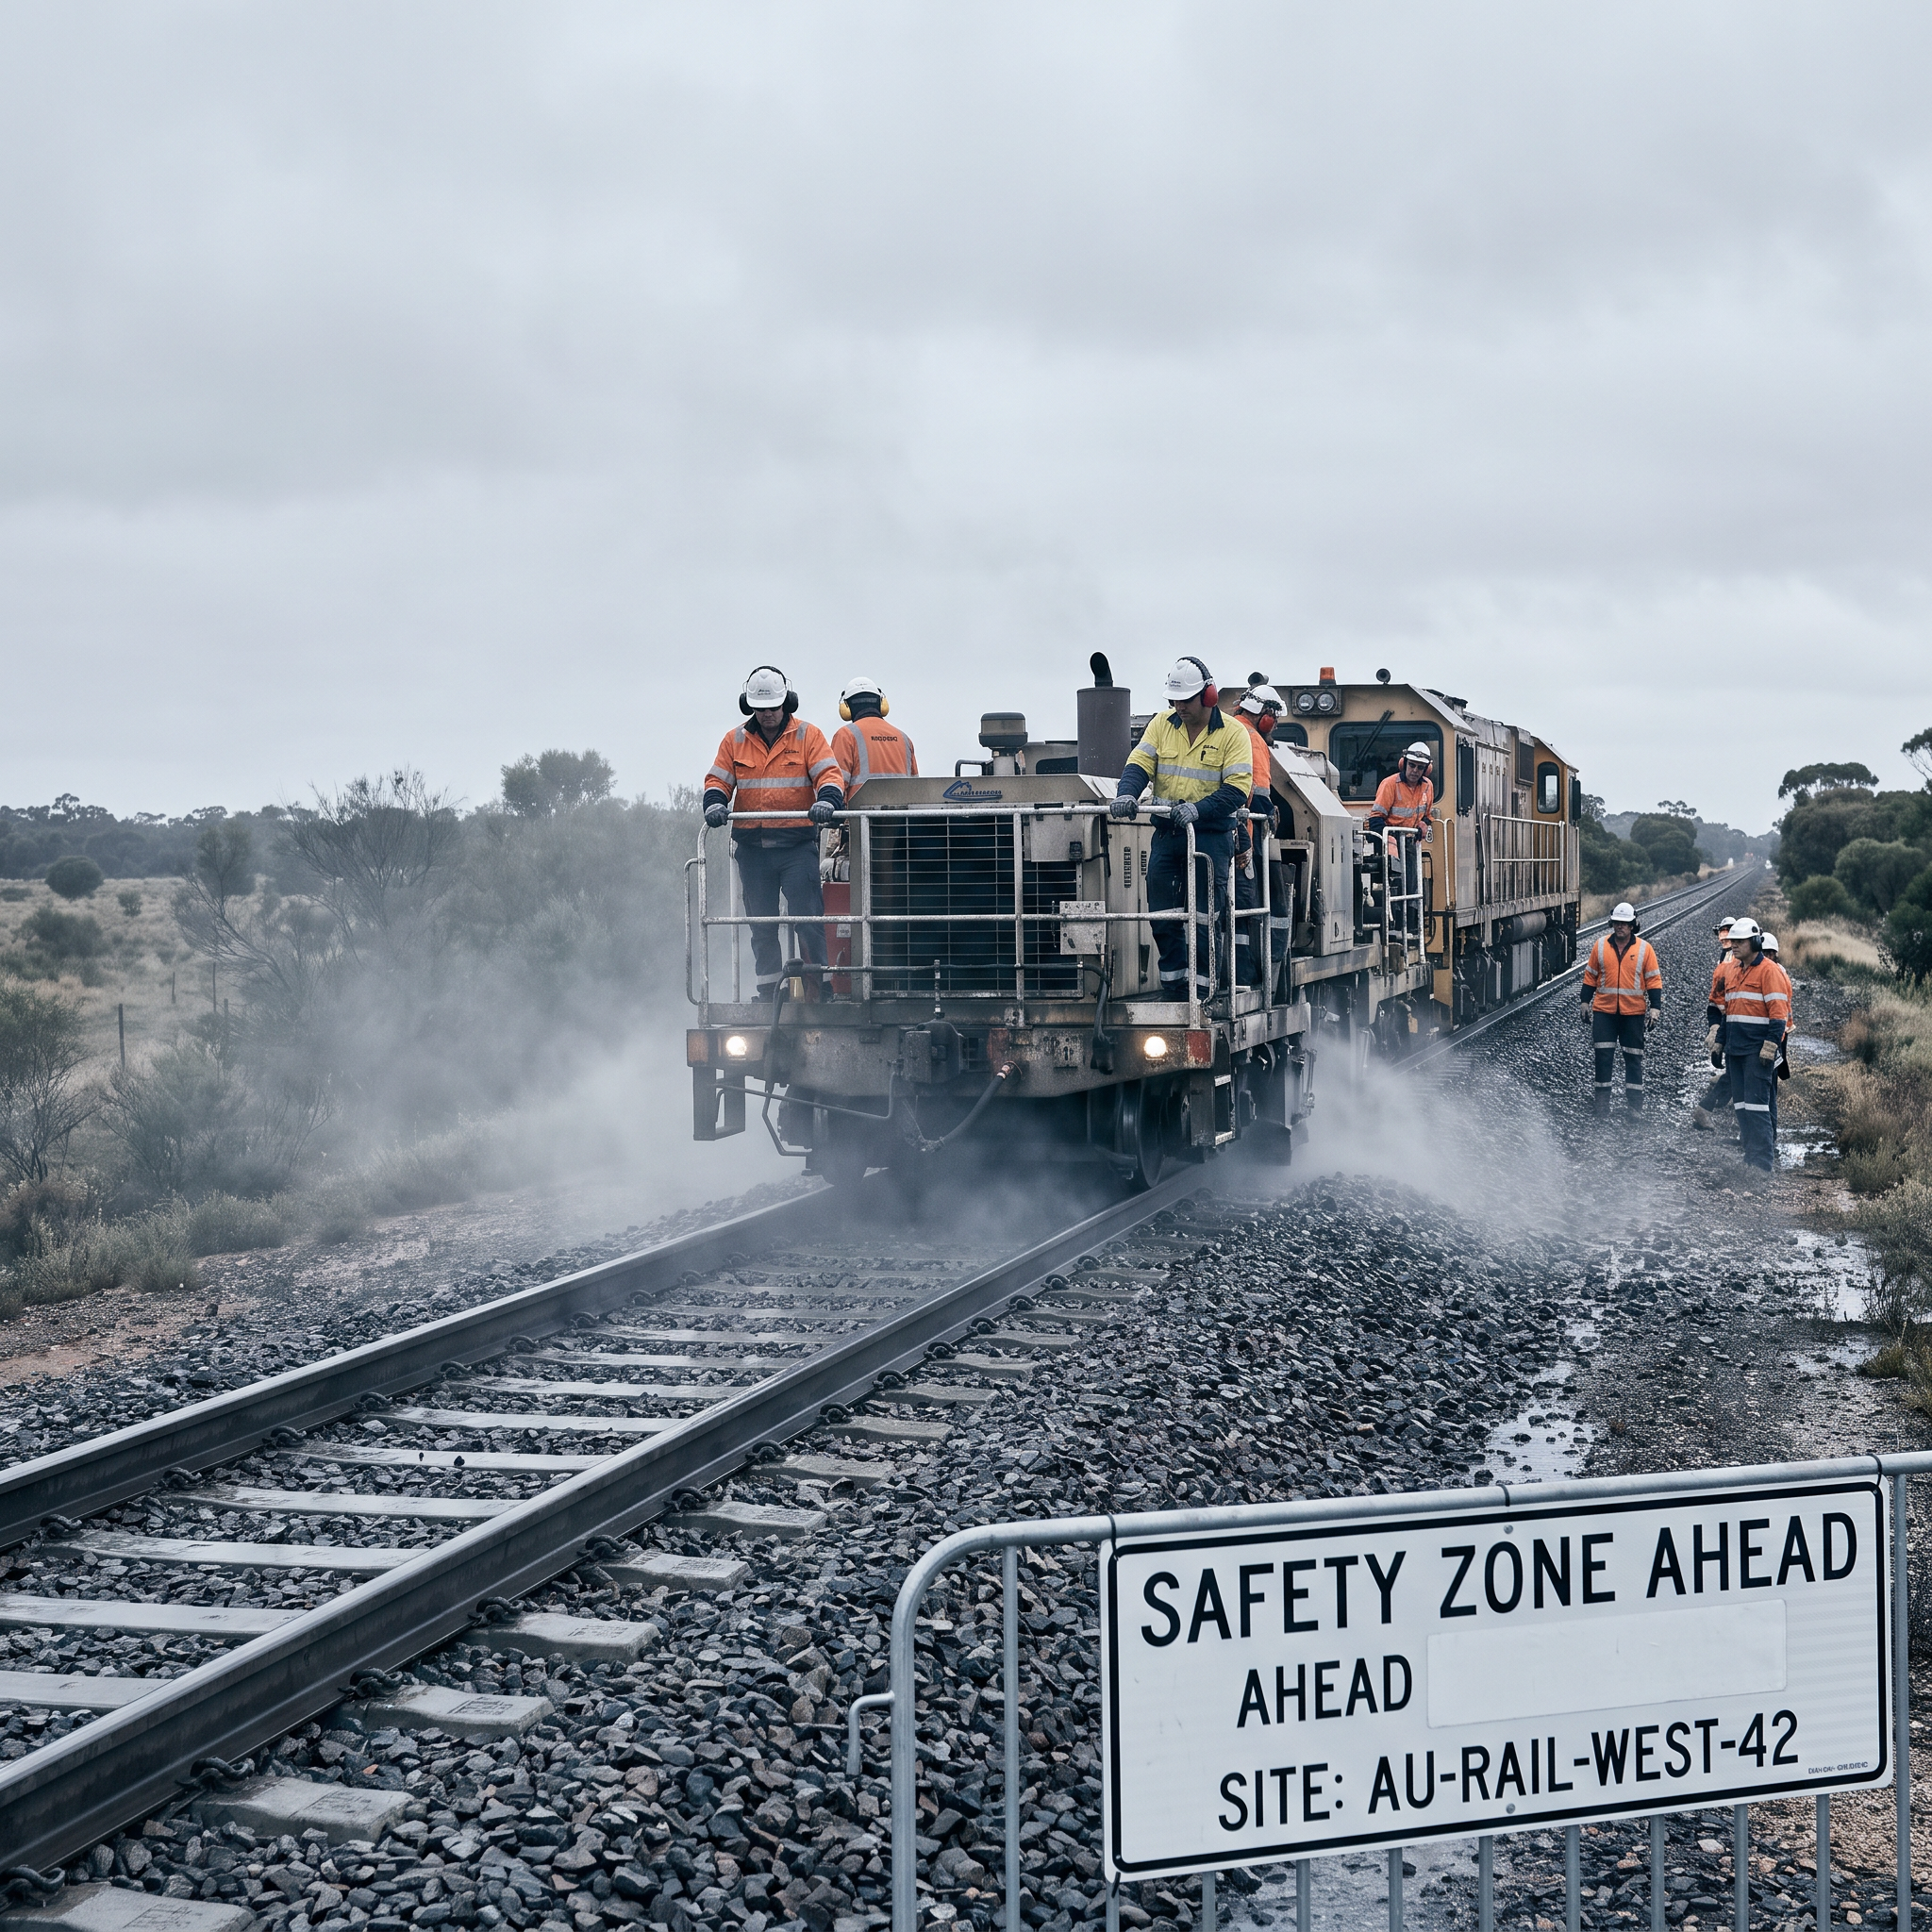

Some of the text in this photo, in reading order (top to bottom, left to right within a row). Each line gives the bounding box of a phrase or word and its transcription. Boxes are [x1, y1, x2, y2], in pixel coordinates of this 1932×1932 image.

[1141, 1511, 1857, 1648] SAFETY ZONE AHEAD
[1236, 1654, 1413, 1729] AHEAD
[1218, 1708, 1799, 1832] SITE: AU-RAIL-WEST-42
